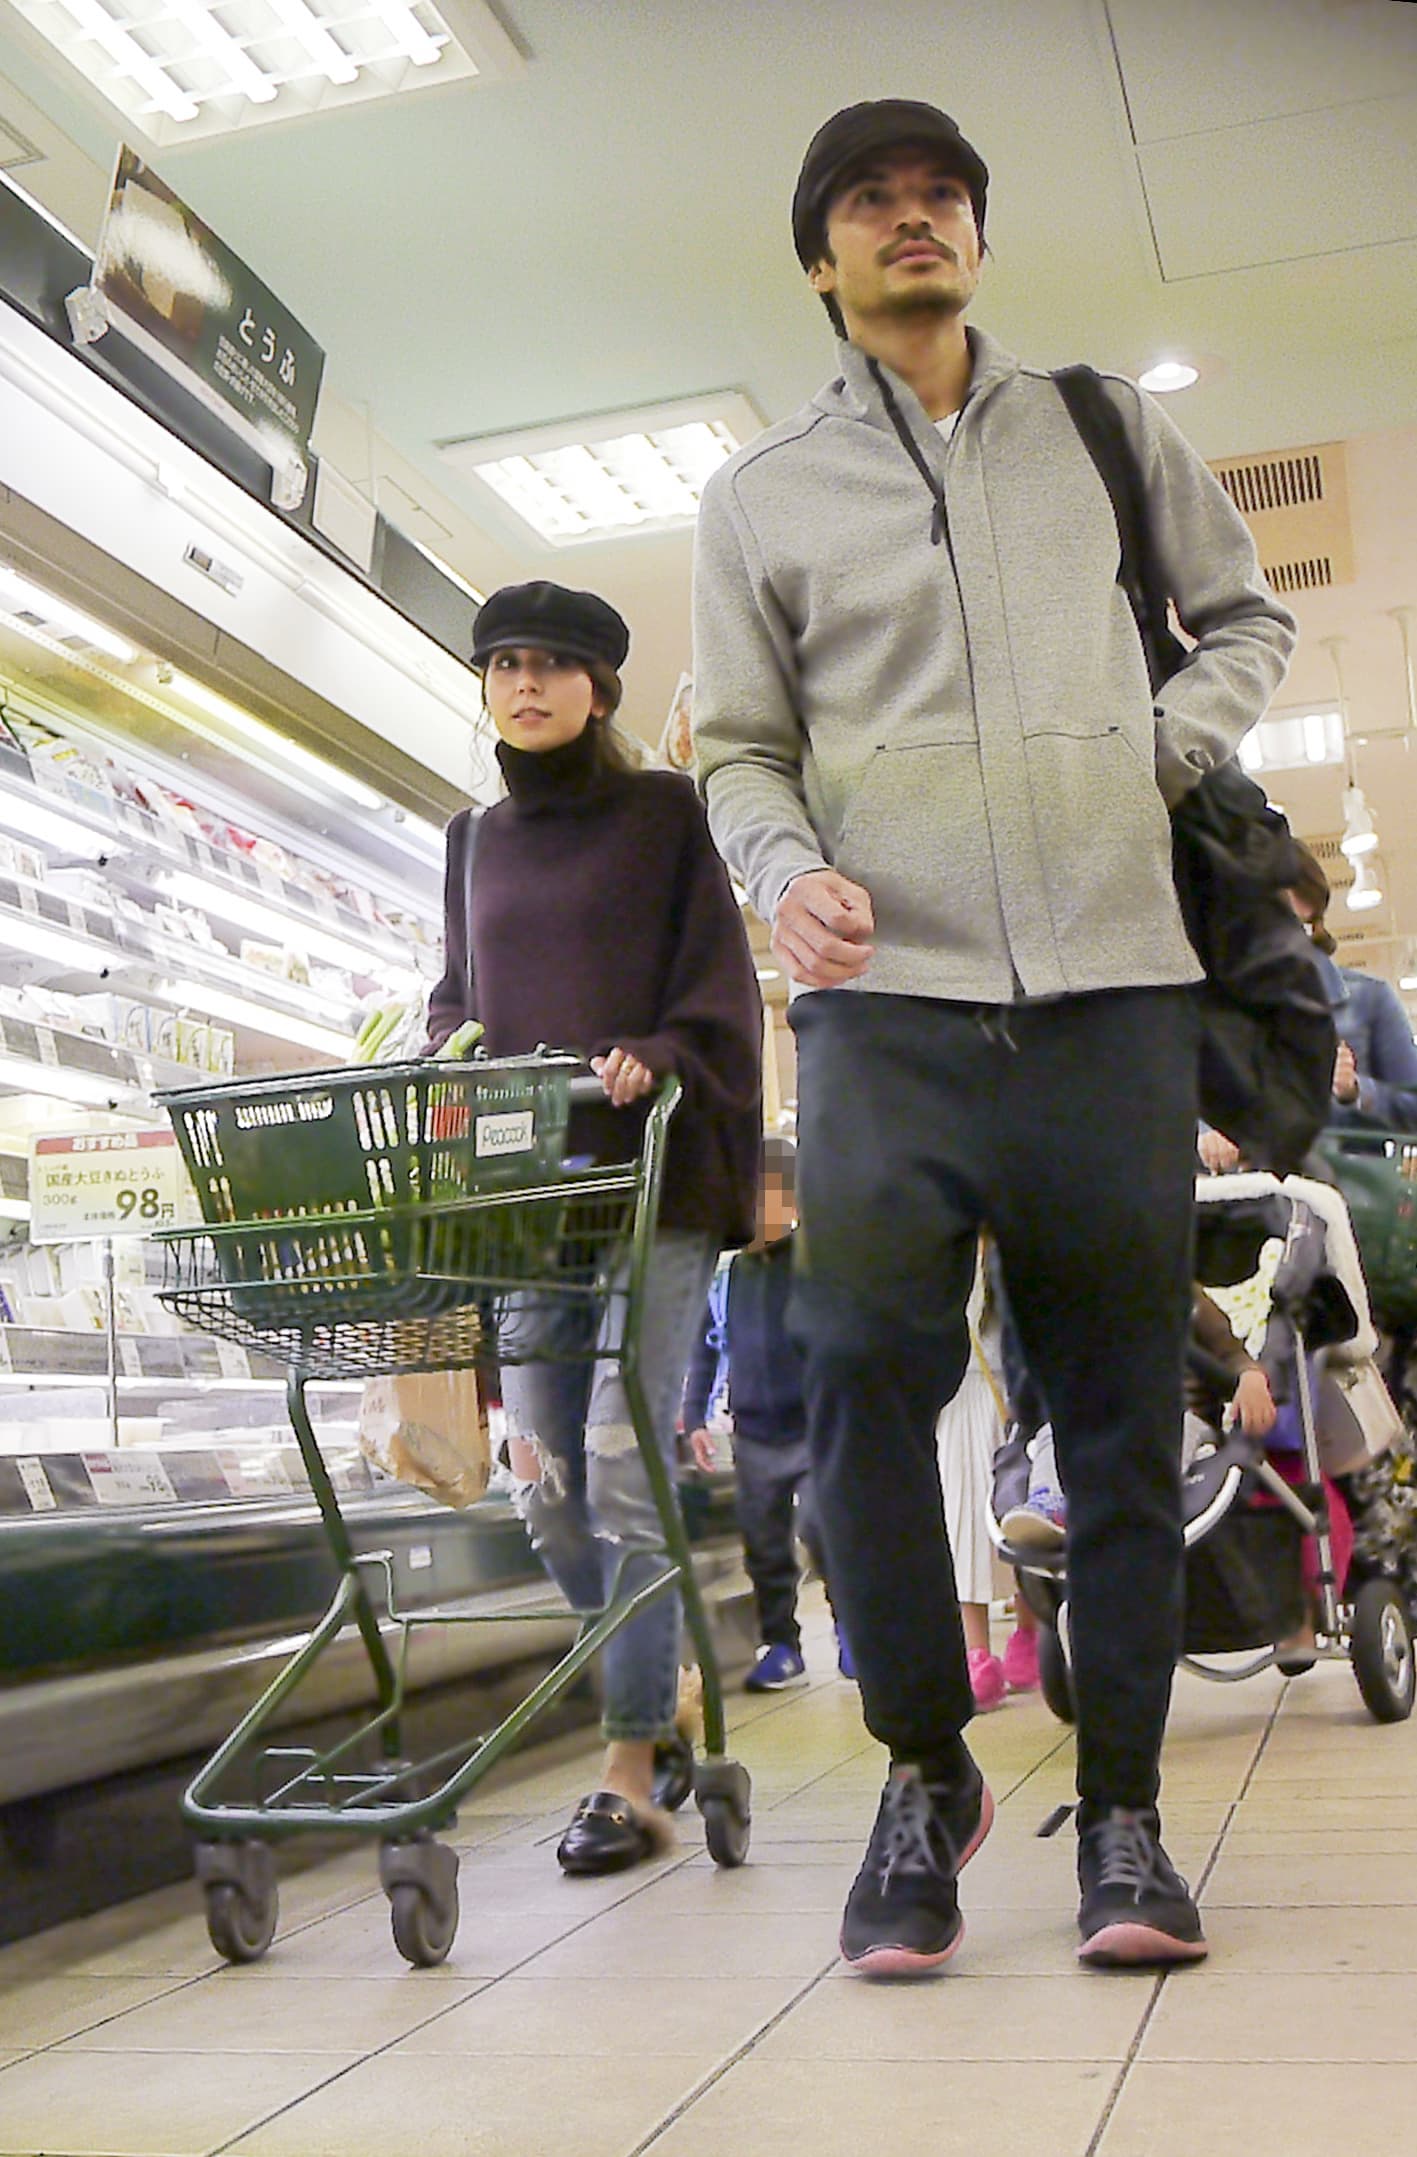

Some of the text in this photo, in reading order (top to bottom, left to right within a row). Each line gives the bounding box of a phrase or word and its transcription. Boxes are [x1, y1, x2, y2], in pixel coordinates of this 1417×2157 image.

[239, 307, 296, 386] とうふ
[46, 1167, 165, 1188] 国産大豆きぬとうふ
